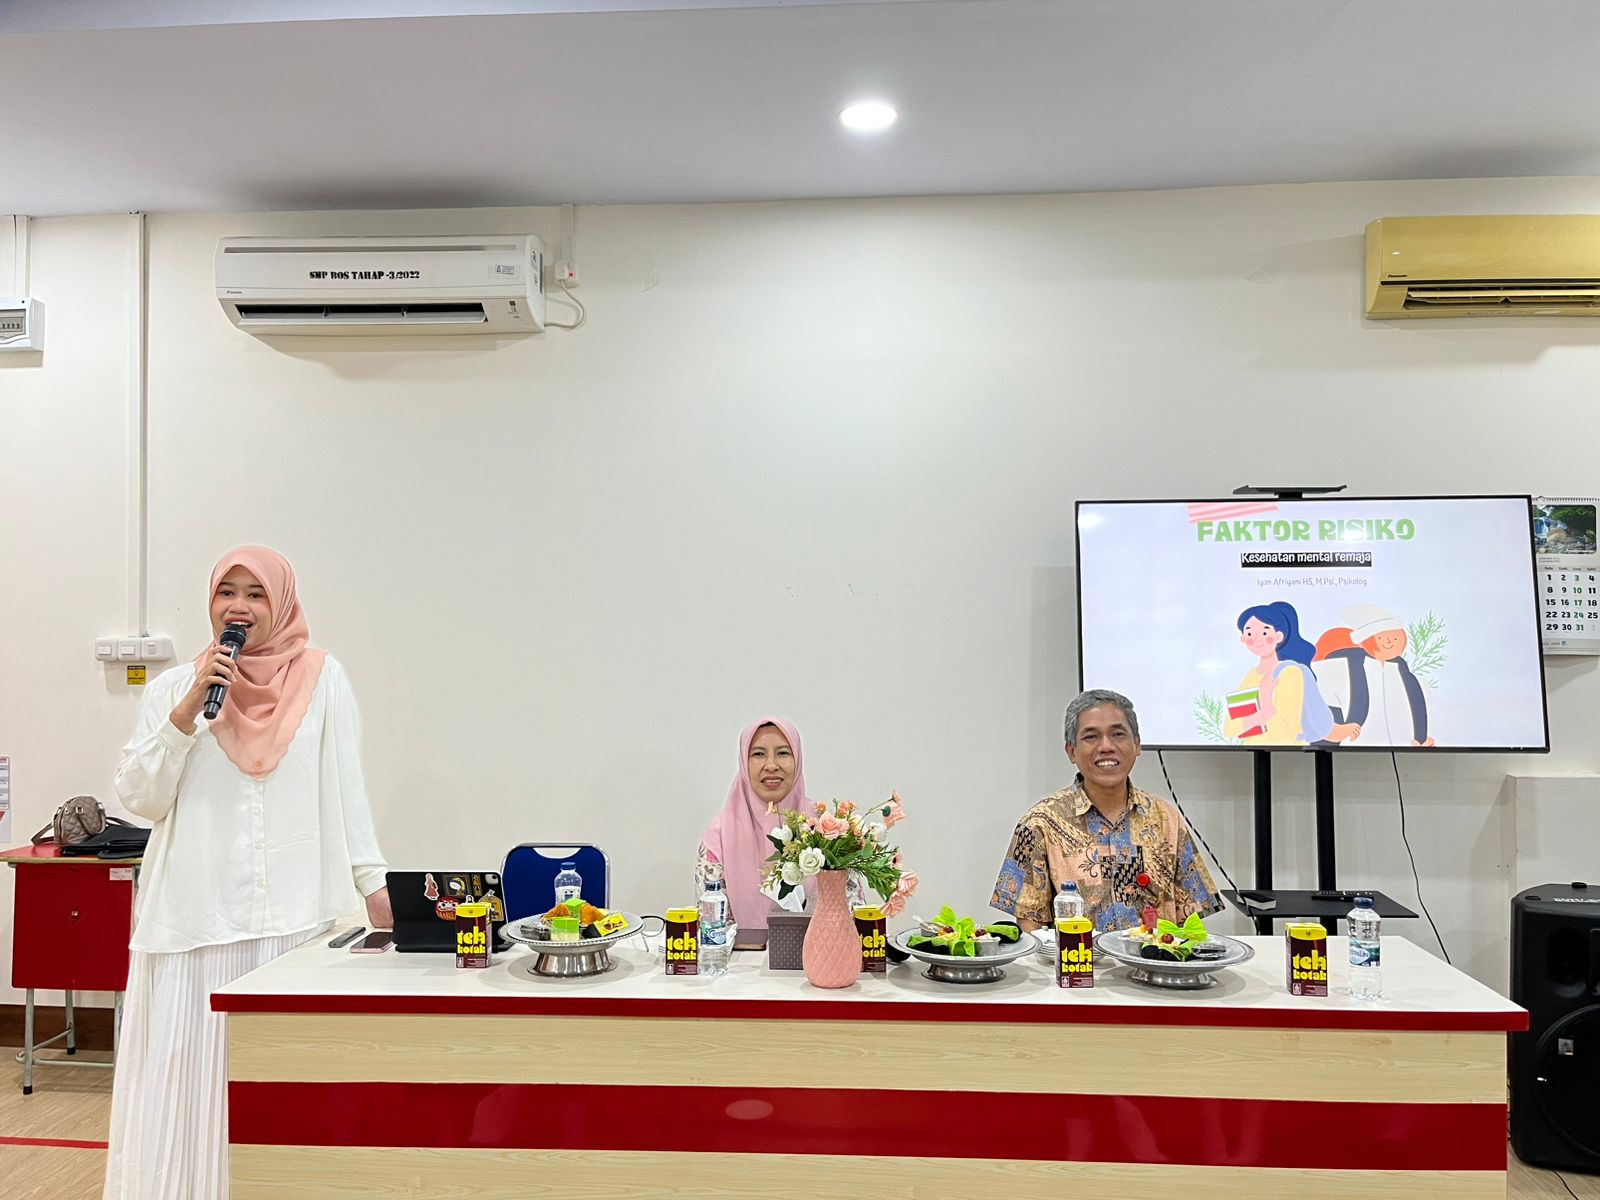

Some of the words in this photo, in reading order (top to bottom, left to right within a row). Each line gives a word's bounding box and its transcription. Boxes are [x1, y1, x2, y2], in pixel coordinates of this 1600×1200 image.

[309, 271, 328, 279] SMP
[351, 271, 385, 280] TAHAP
[1197, 520, 1311, 542] FAKTOR
[1318, 518, 1416, 541] RISIKO
[1241, 553, 1295, 564] Kesehatan
[1297, 552, 1333, 563] mental
[1335, 552, 1371, 564] remaja
[1338, 578, 1368, 587] Psikolog
[457, 926, 486, 945] teh
[667, 932, 697, 951] teh
[457, 945, 486, 954] kotak
[667, 951, 697, 960] kotak
[862, 948, 886, 957] otak
[1061, 943, 1093, 963] teh
[1292, 950, 1327, 970] teh
[1061, 963, 1093, 973] kotak
[1293, 969, 1327, 981] kotak
